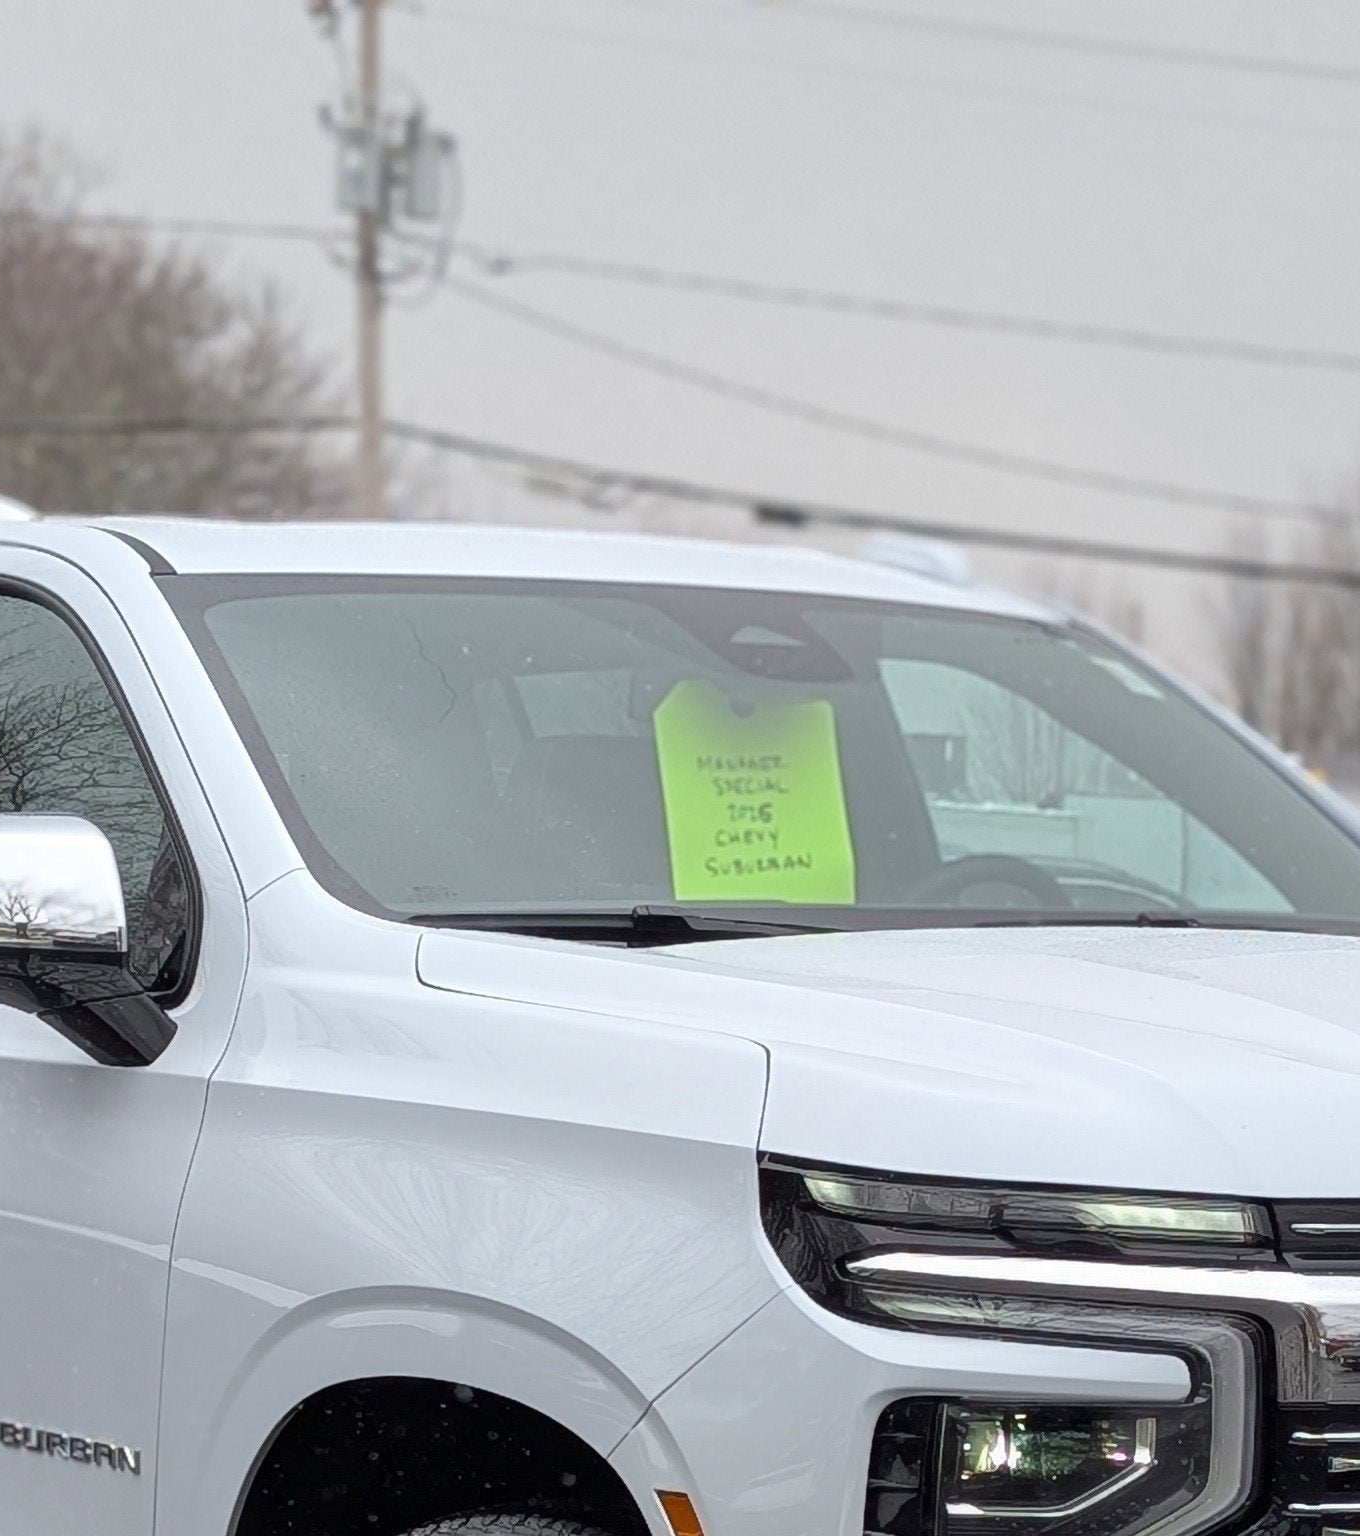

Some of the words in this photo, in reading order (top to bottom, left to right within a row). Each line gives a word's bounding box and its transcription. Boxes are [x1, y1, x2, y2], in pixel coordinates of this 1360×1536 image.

[712, 776, 791, 796] SPECIAL
[715, 826, 780, 850] CHEVY
[704, 852, 813, 877] SUBURBAN
